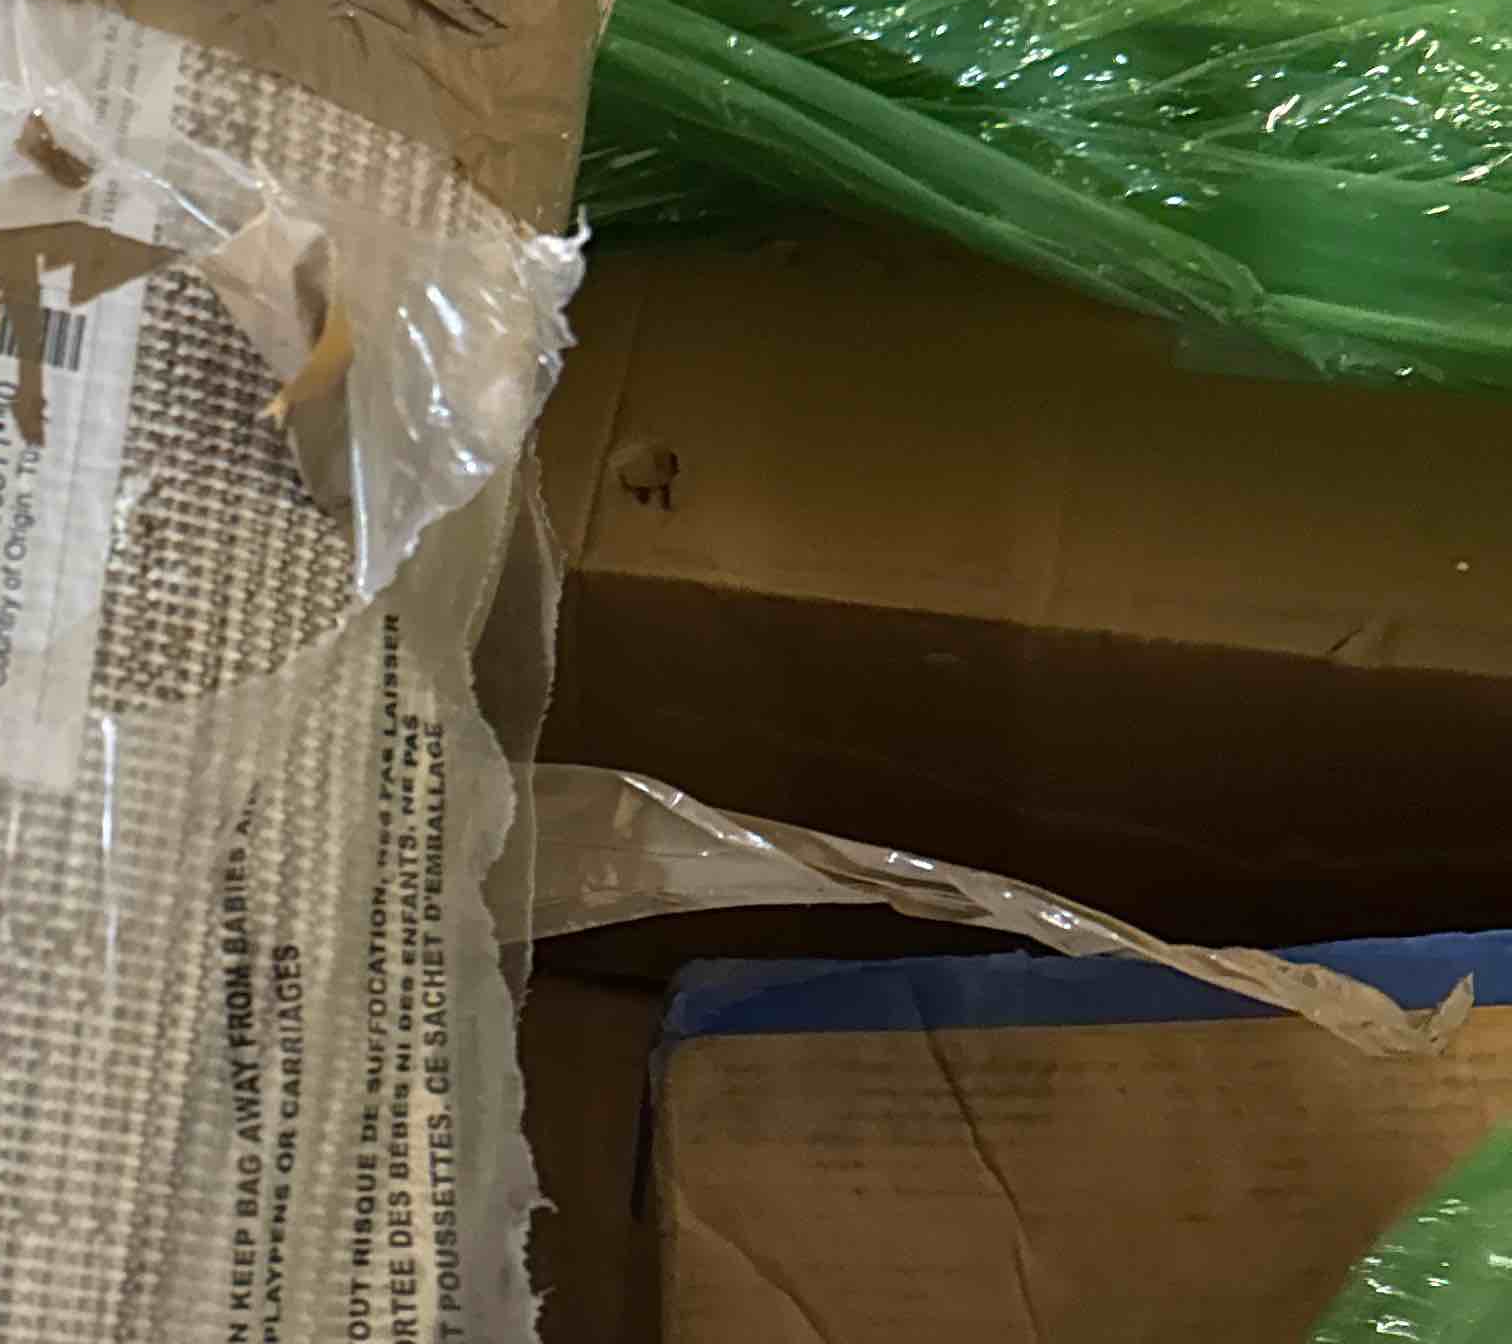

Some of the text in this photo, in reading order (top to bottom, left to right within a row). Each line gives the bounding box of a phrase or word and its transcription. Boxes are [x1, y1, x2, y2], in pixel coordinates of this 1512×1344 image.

[382, 612, 401, 737] LAISSER
[377, 747, 394, 801] PAS
[402, 713, 420, 767] PAS
[401, 776, 416, 816] NE
[422, 721, 446, 922] D'EMBALLAGE
[221, 847, 249, 956] BABIES
[221, 963, 256, 1049] FROM
[363, 876, 389, 1094] SUFFOCATION,
[399, 976, 415, 1031] DES
[419, 932, 449, 1047] SACHET
[273, 943, 305, 1119] CARRIAGES
[395, 1042, 412, 1072] NI
[231, 1059, 263, 1144] AWAY
[424, 1055, 451, 1094] CE
[275, 1129, 297, 1174] OR
[360, 1103, 379, 1143] DE
[235, 1153, 263, 1218] BAG
[350, 1153, 377, 1267] RISQUE
[387, 1189, 414, 1248] DES
[427, 1103, 462, 1312] POUSSETTES.
[227, 1228, 257, 1312] KEEP
[263, 1183, 292, 1344] PLAYPENS
